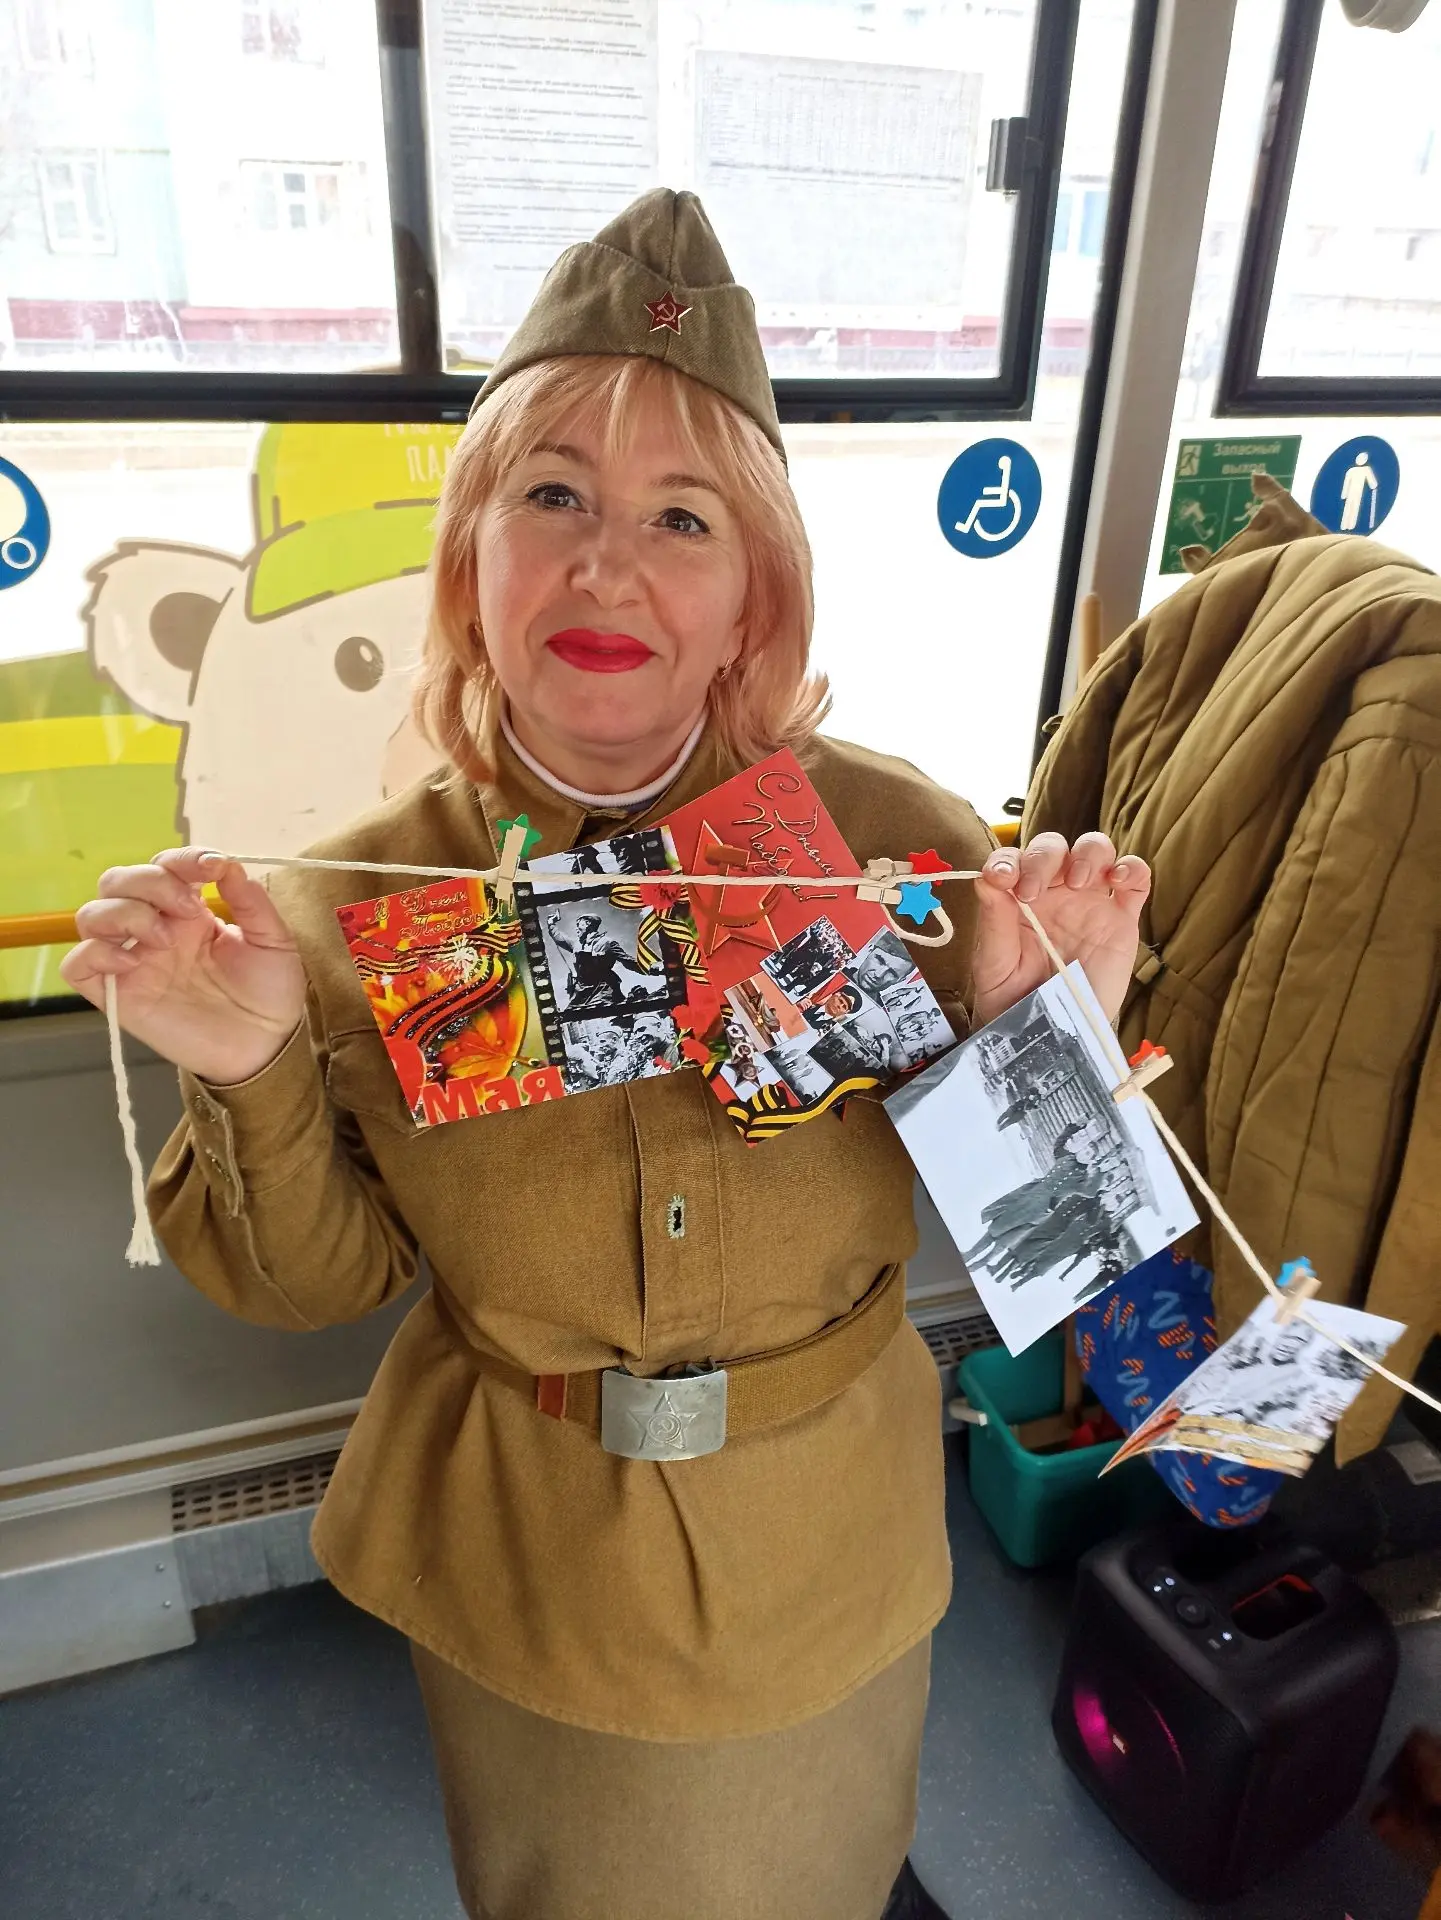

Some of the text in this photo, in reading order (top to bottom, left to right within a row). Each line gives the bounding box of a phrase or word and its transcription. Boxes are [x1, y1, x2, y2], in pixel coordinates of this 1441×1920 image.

[1213, 441, 1281, 457] Запасный
[757, 771, 802, 800] С
[420, 1065, 567, 1126] Мая
